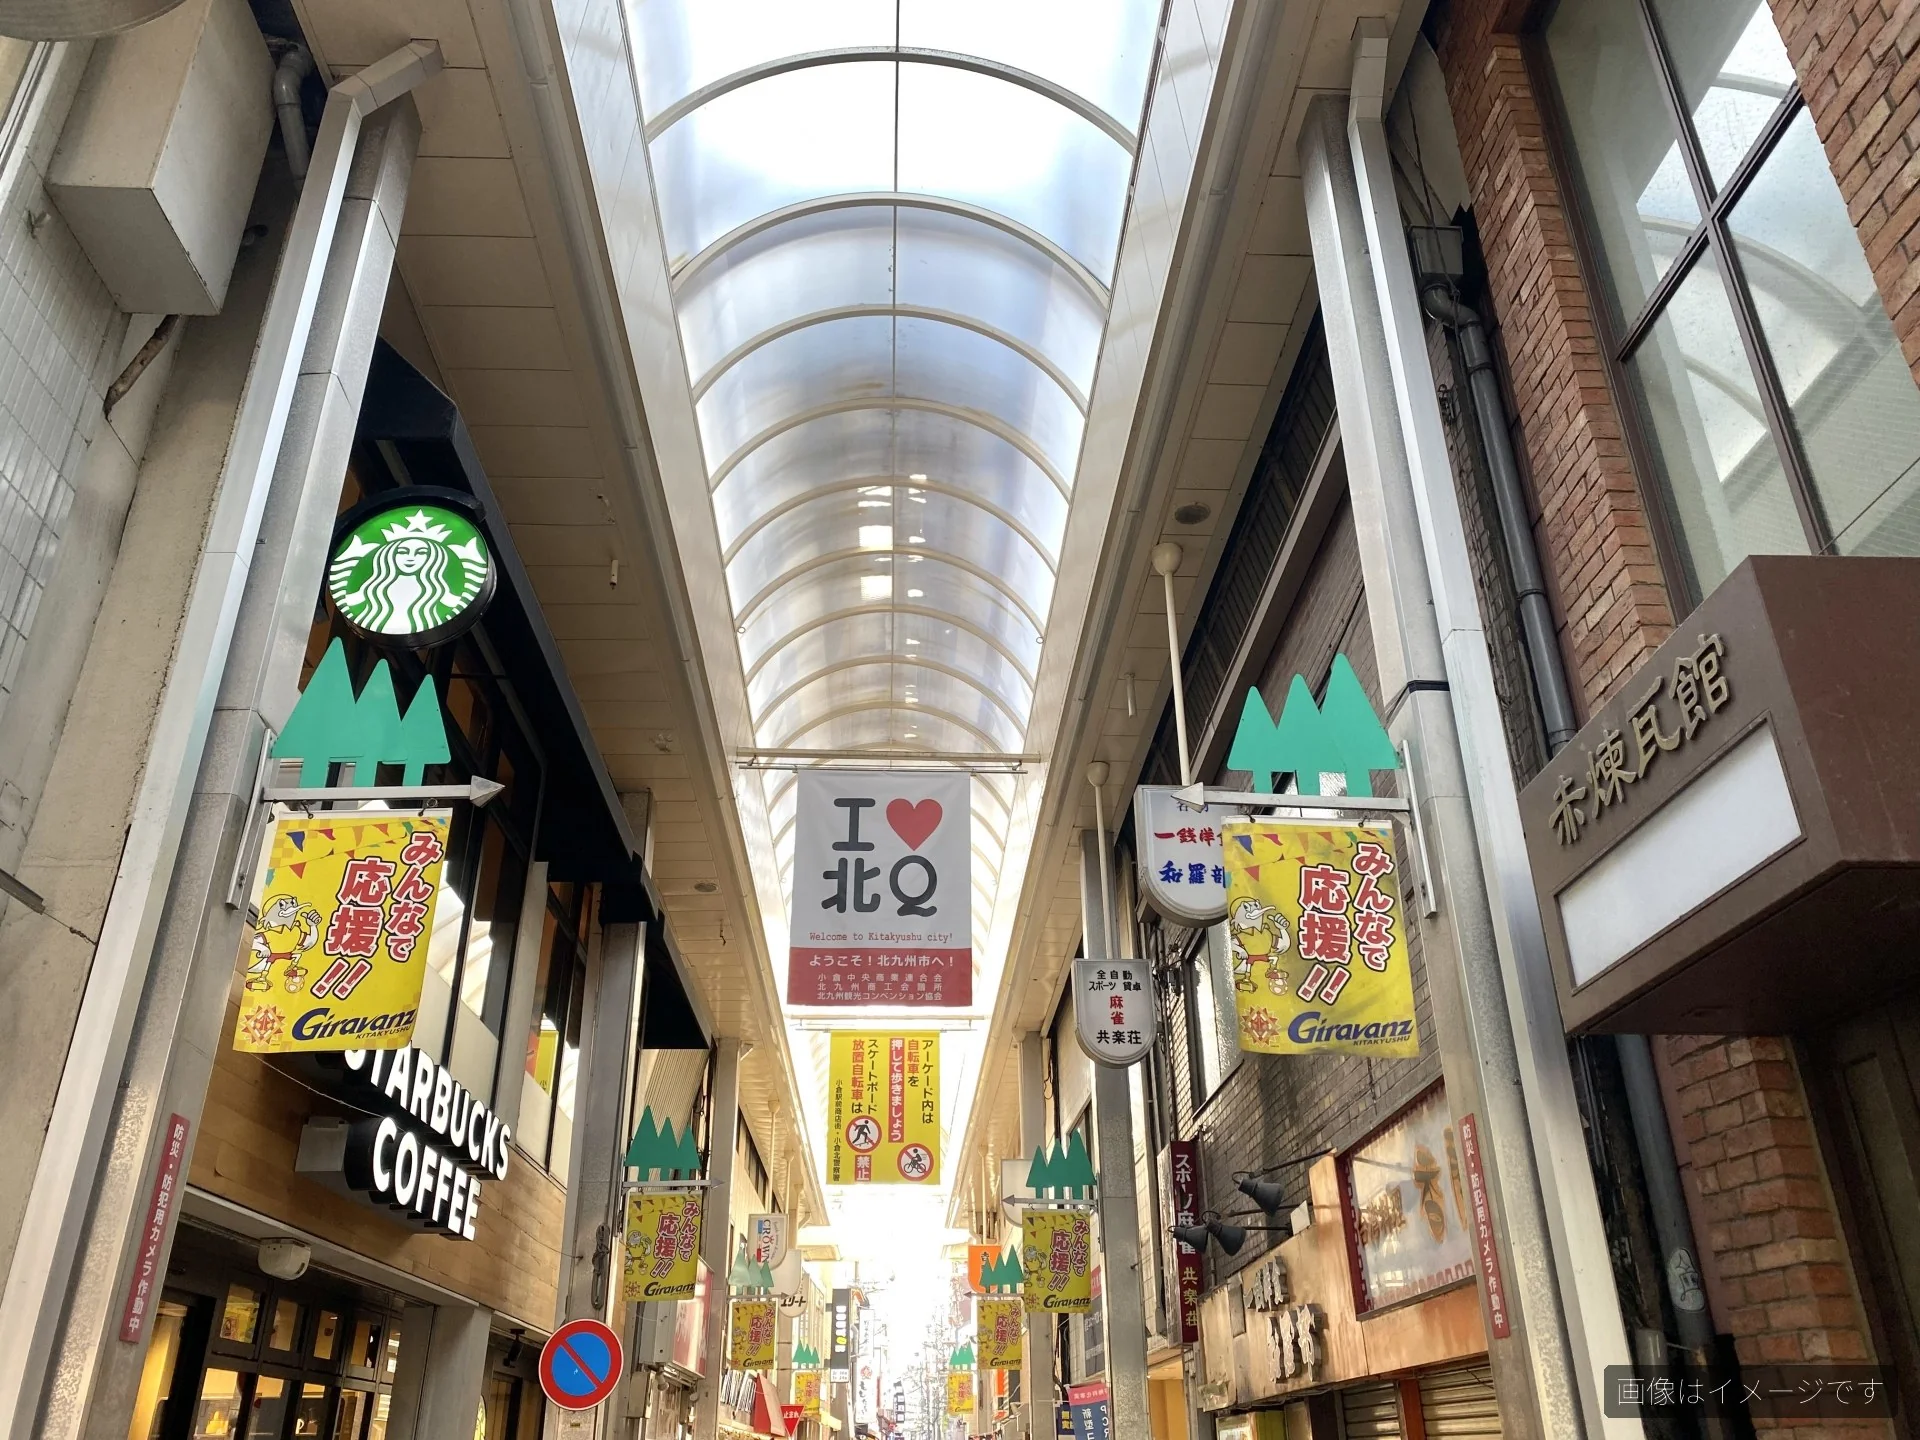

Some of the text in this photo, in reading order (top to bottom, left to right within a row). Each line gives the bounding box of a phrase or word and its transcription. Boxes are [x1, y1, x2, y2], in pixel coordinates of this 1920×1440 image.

[1548, 632, 1730, 846] 赤煉瓦館
[832, 798, 876, 851] I
[386, 832, 443, 962] みんなで
[821, 855, 938, 917] 北Q
[1352, 842, 1395, 972] みんなで
[809, 932, 953, 943] Welcome to Kitakyushu city!
[1088, 981, 1116, 991] スポーツ
[1096, 969, 1133, 980] 全自動
[817, 992, 942, 1001] 北九州観光コンベンション協会
[1110, 995, 1124, 1025] 麻雀
[291, 1007, 416, 1041] Giravanz
[356, 1025, 412, 1040] KITAKYUSHU
[1096, 1029, 1142, 1045] 共楽荘
[1287, 1011, 1414, 1044] Giravanz
[1353, 1035, 1411, 1047] KITAKYUSHU
[851, 1039, 865, 1114] 放置自転車は
[907, 1039, 920, 1087] 自転車を
[922, 1039, 934, 1124] アーケード内は
[891, 1039, 903, 1141] 押して歩きましょう
[373, 1117, 481, 1241] COFFEE
[856, 1155, 870, 1181] 禁止
[679, 1201, 700, 1262] みんなで
[1072, 1219, 1090, 1277] みんなで
[1043, 1294, 1091, 1308] Giravanz
